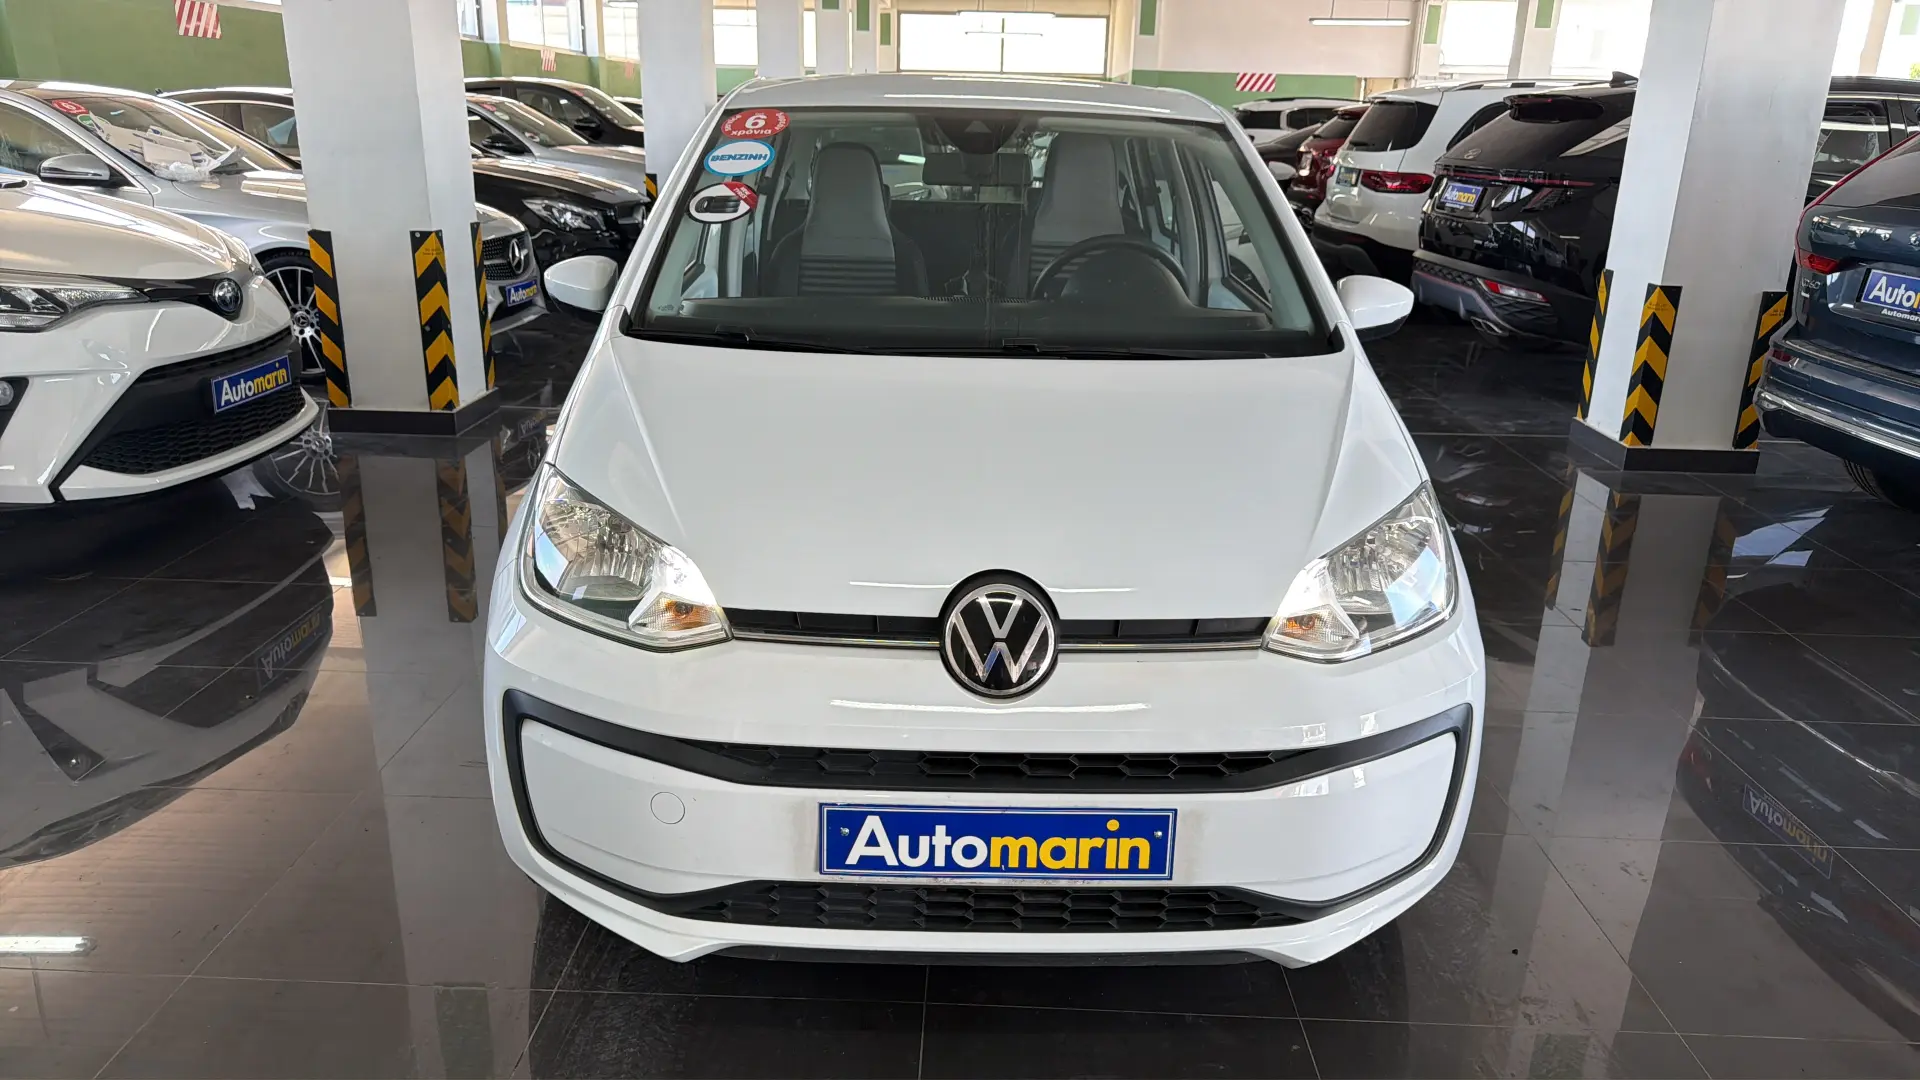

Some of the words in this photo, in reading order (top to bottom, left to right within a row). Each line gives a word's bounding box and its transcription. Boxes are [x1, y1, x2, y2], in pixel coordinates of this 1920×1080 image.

[731, 128, 772, 136] χρόνια
[745, 115, 767, 129] 6
[221, 362, 288, 406] Automarin
[948, 586, 1051, 688] VW
[845, 815, 1150, 870] Automarin
